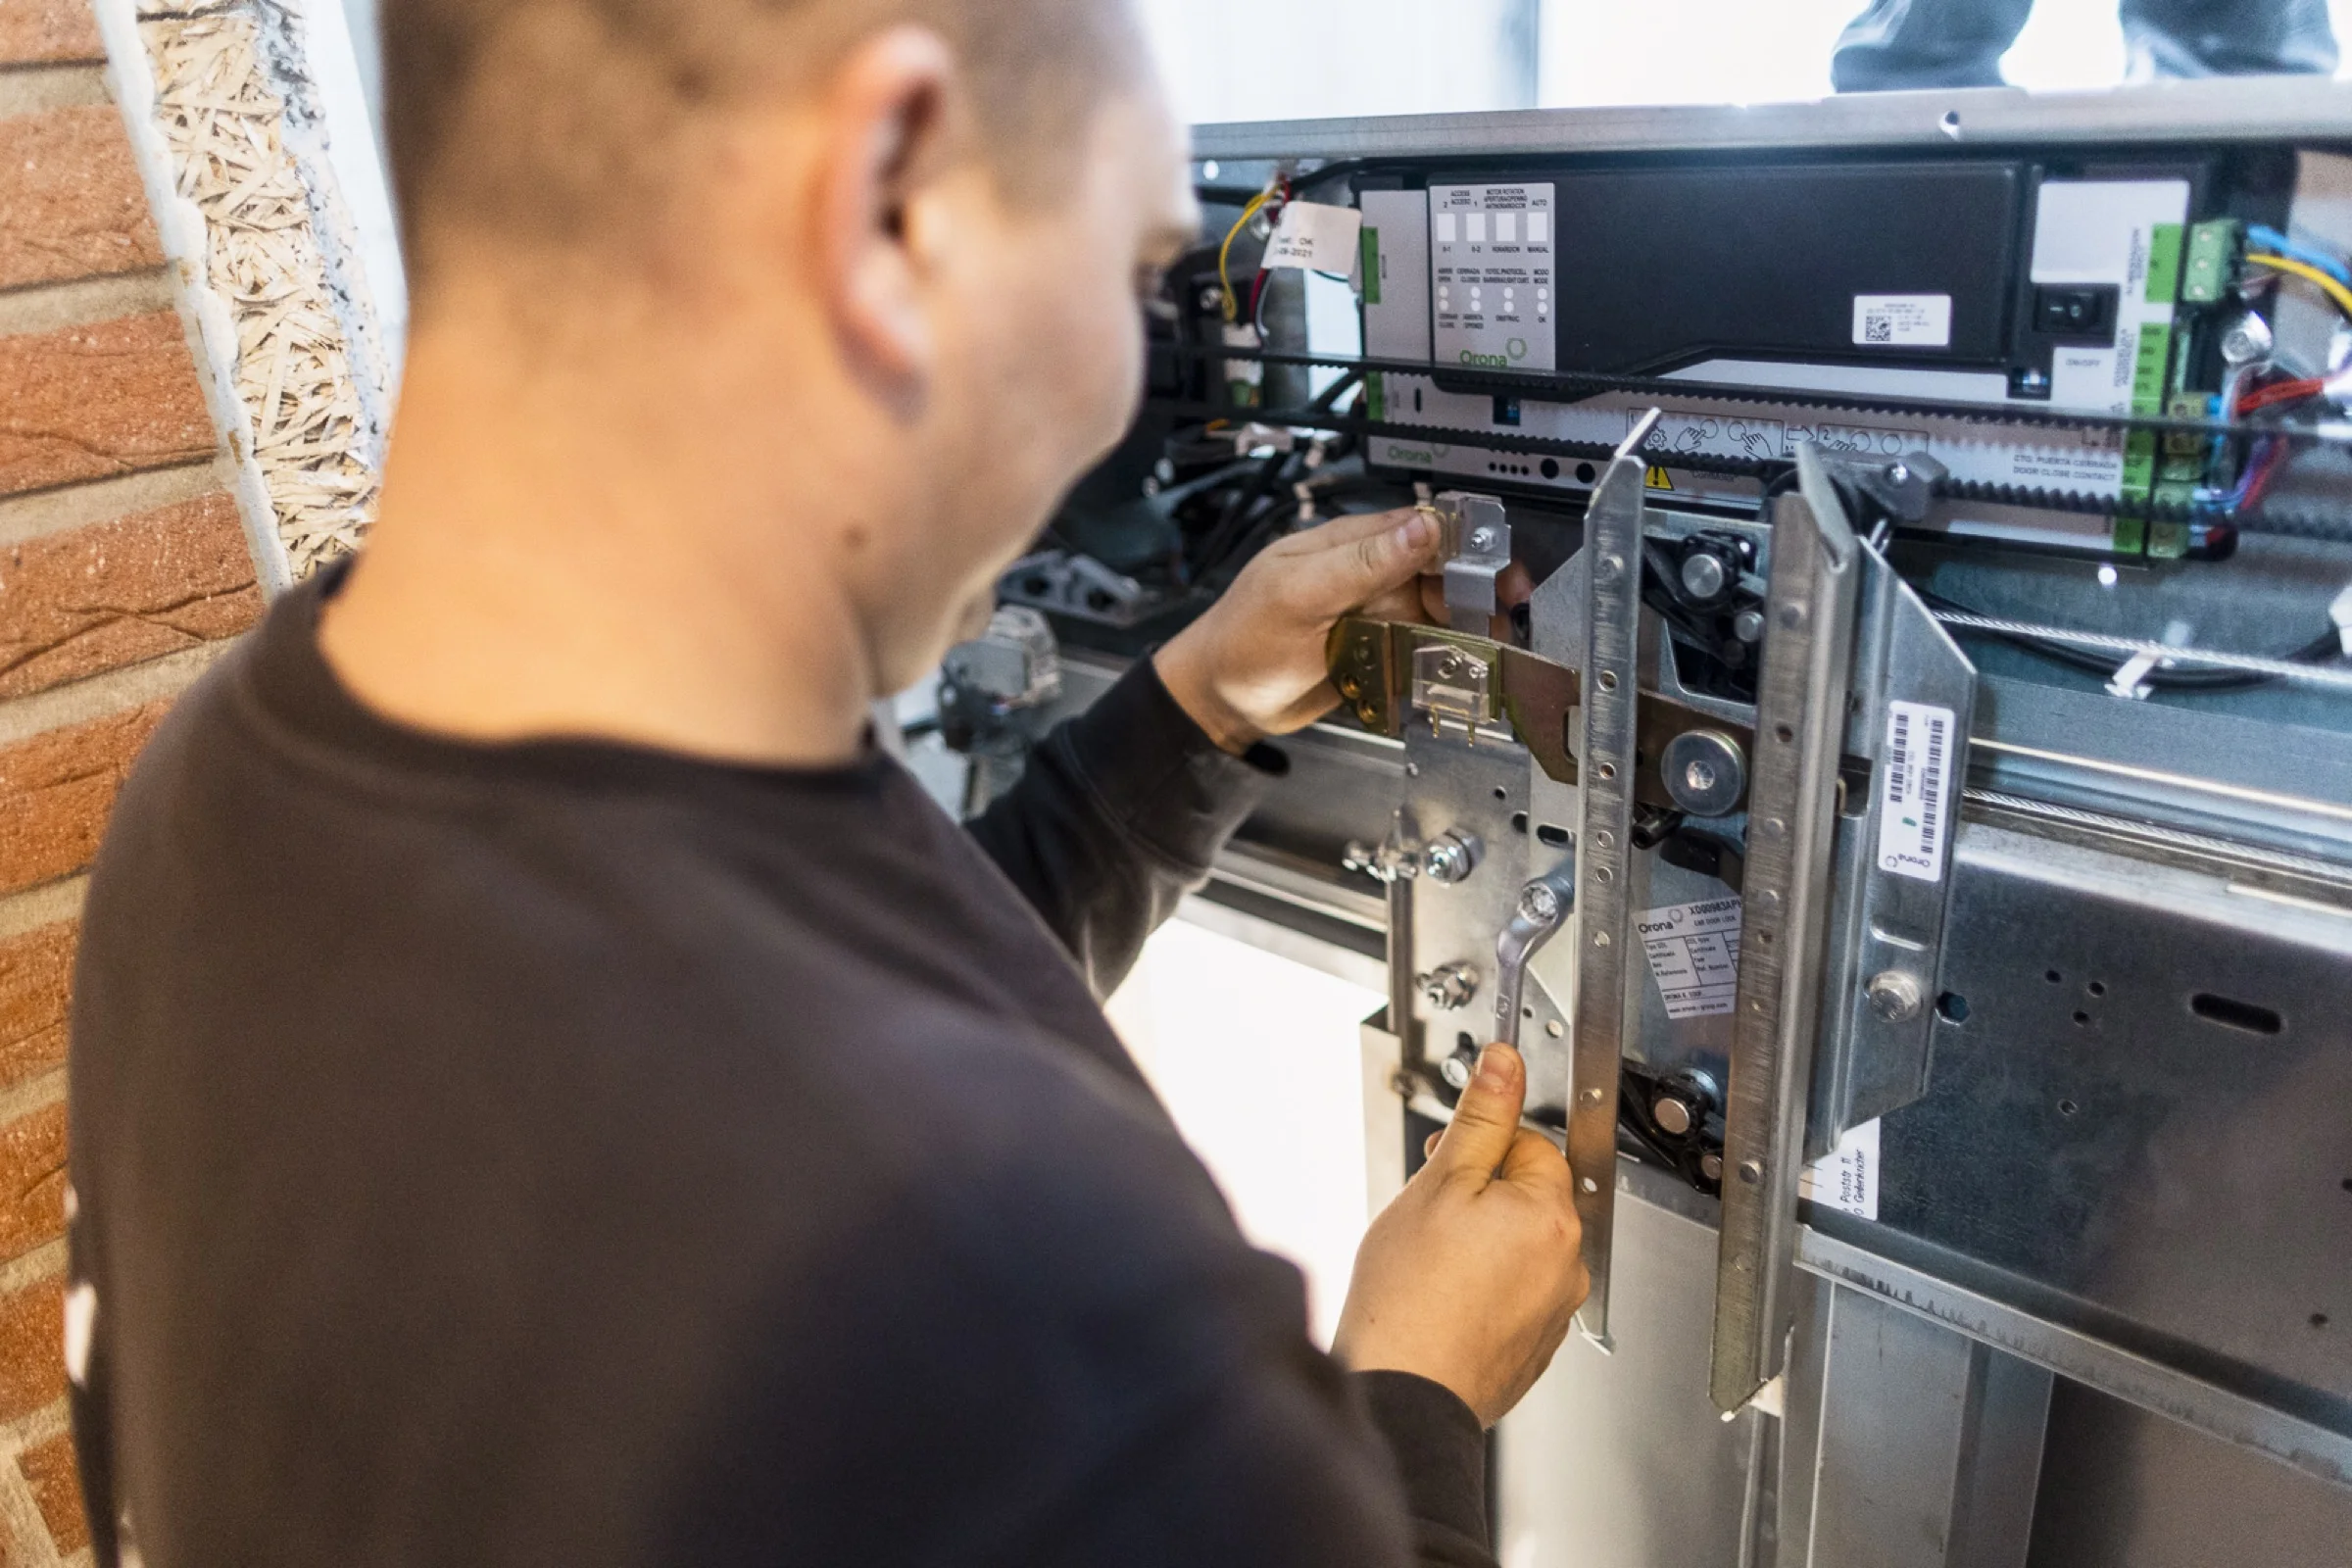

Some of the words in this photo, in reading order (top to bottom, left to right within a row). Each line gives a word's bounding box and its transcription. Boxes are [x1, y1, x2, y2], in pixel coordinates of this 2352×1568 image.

[1459, 349, 1507, 367] Orona
[1387, 445, 1432, 465] Orona
[1639, 921, 1674, 933] Orona
